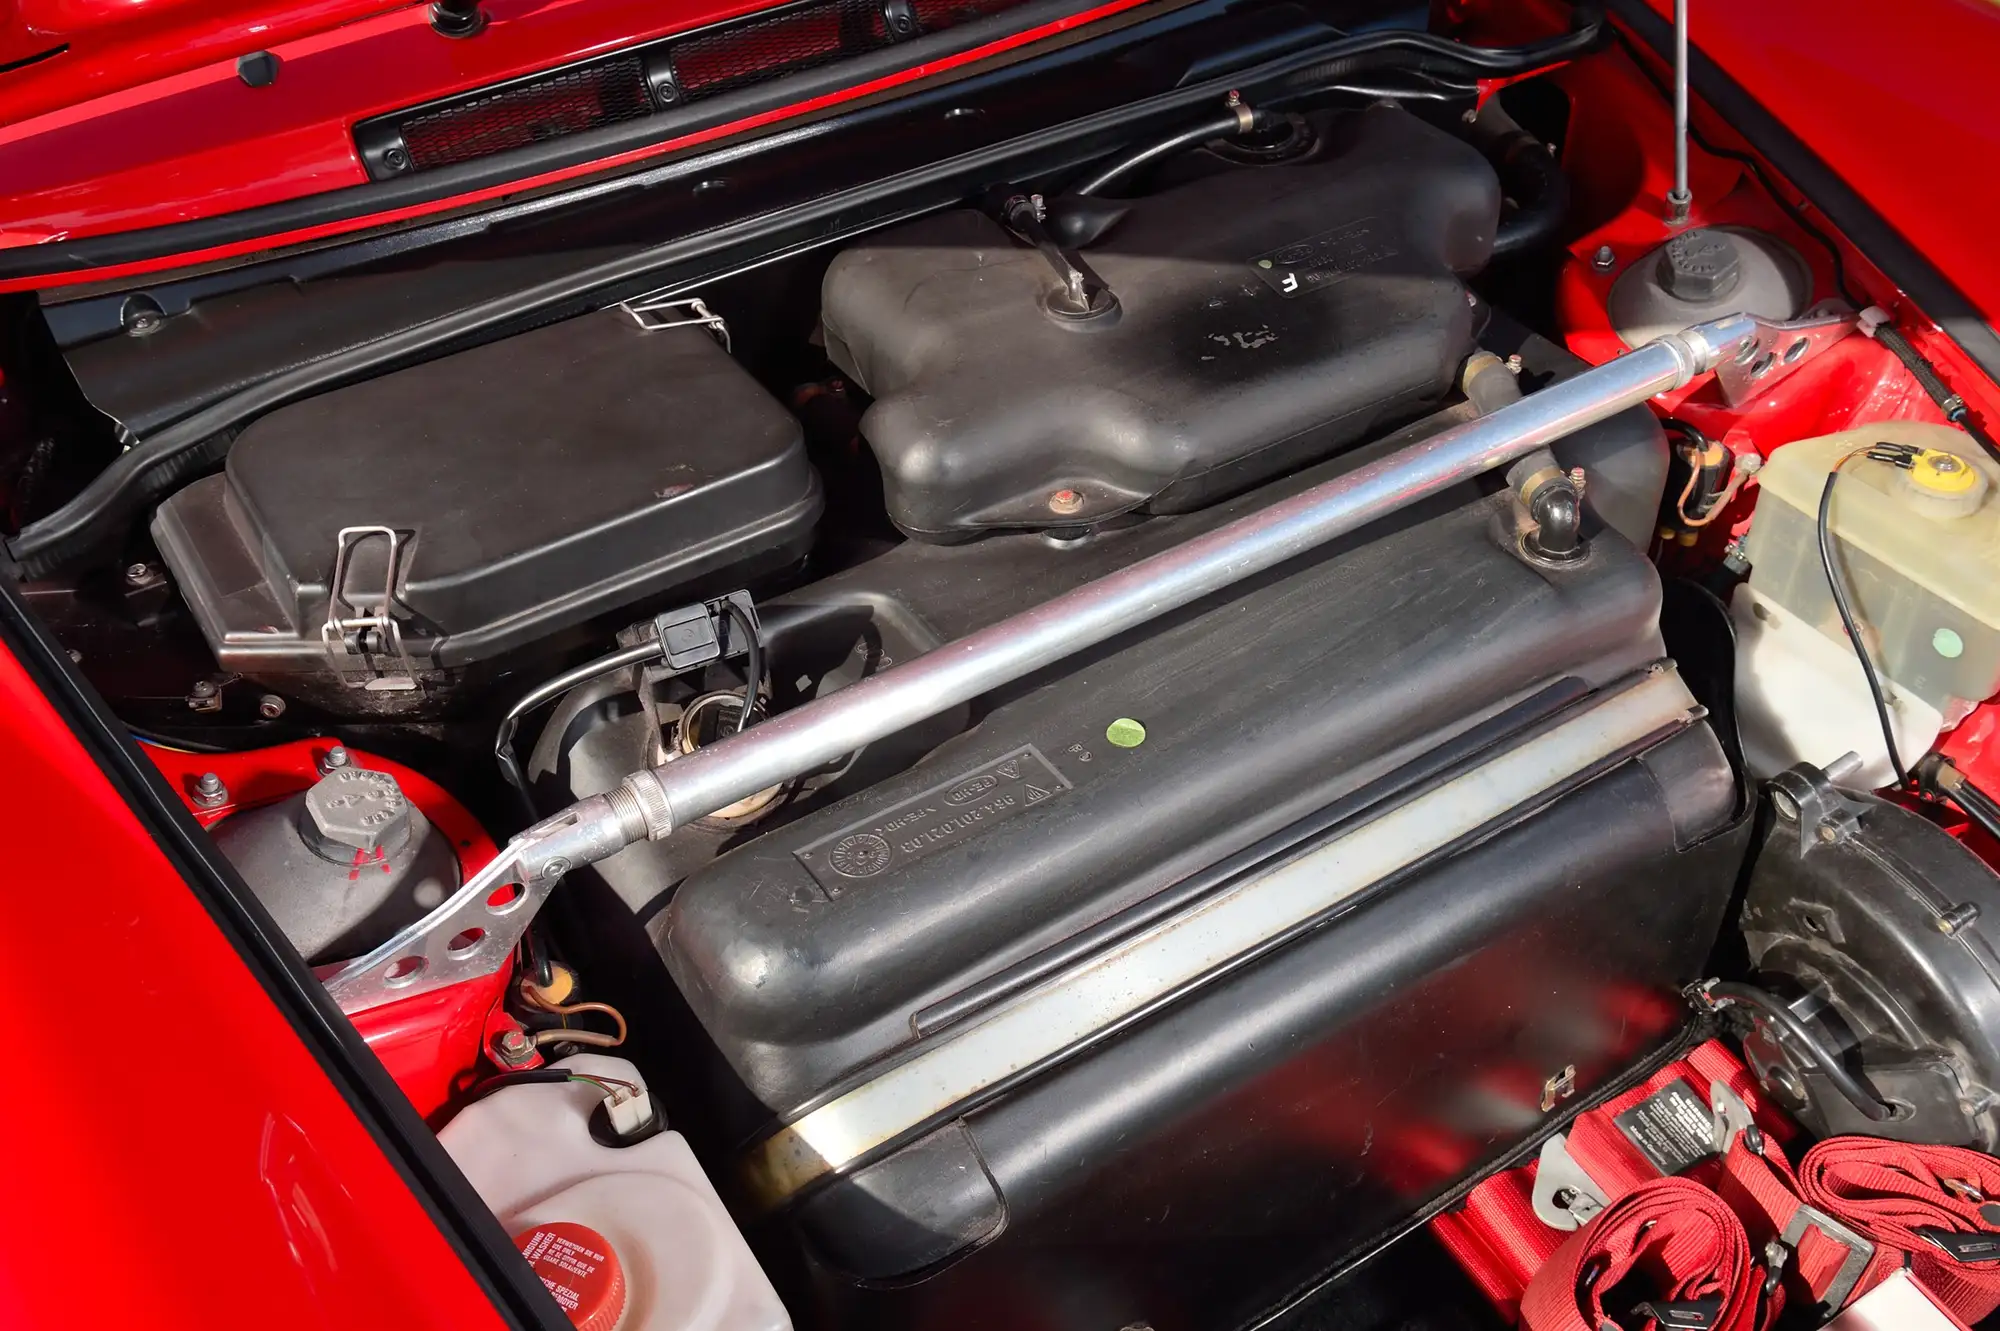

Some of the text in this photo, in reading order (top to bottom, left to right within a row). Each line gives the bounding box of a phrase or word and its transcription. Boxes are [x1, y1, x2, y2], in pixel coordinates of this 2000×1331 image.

[1282, 273, 1298, 292] F
[531, 1232, 556, 1259] WASHER
[555, 1285, 579, 1301] SPEZIAL
